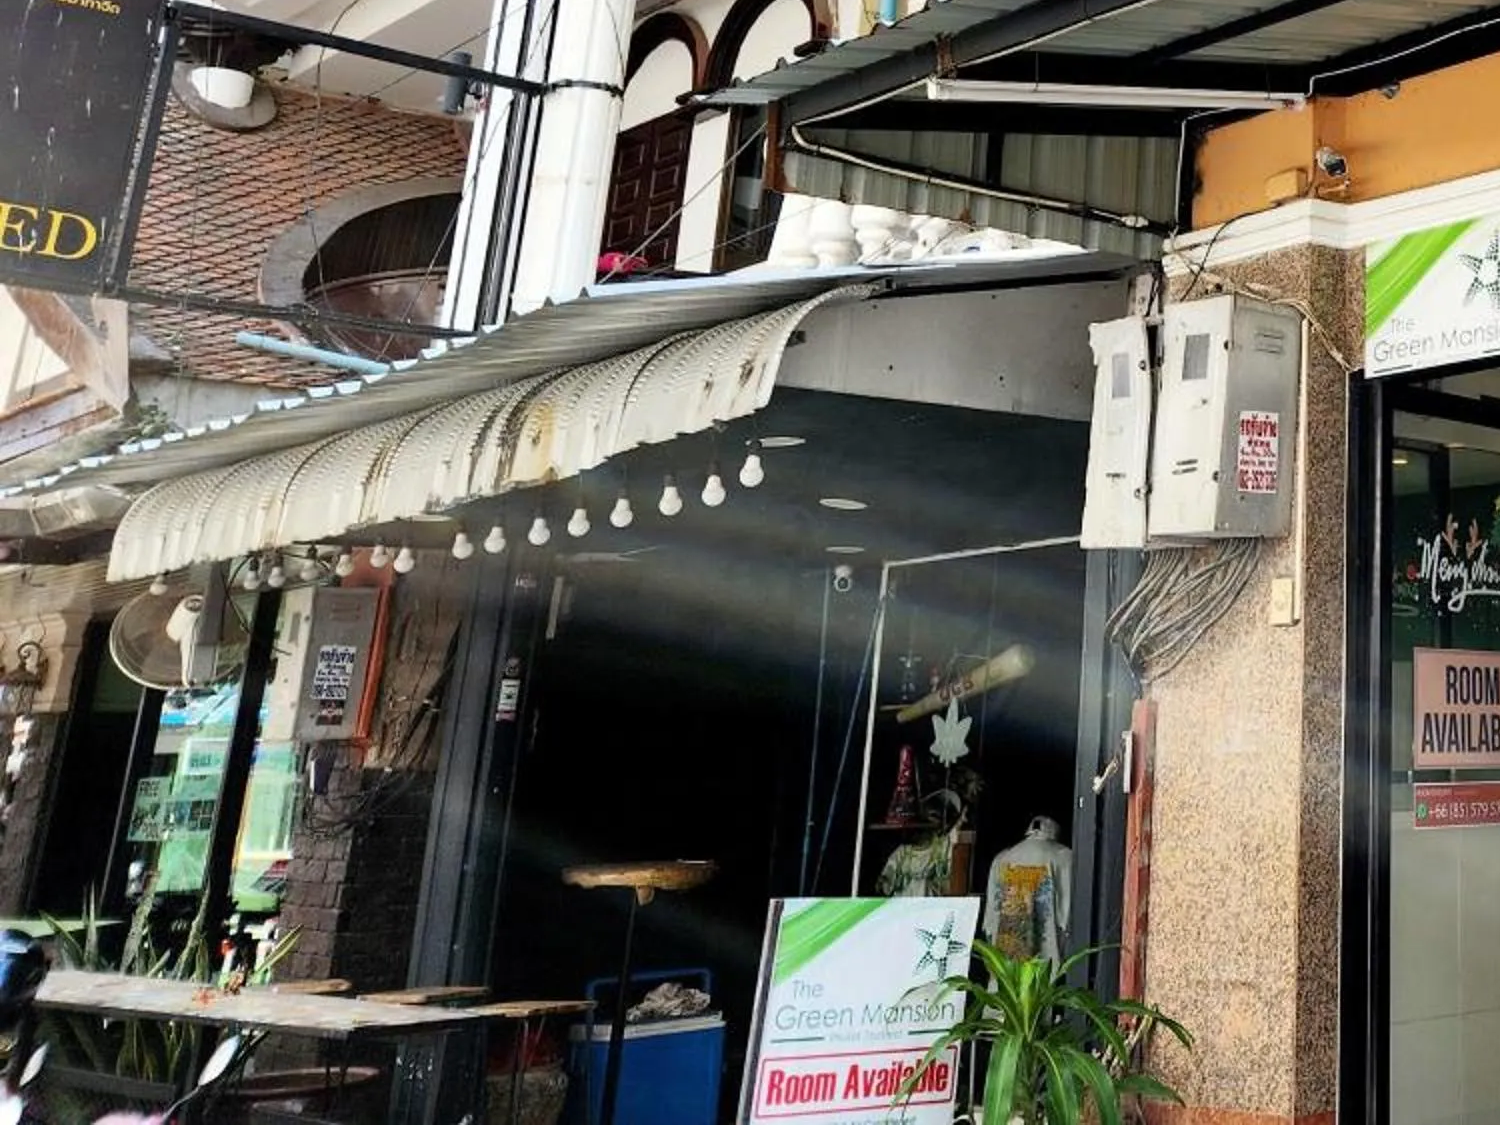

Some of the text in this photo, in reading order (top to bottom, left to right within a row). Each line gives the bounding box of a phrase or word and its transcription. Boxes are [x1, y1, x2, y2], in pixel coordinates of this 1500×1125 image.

[1373, 334, 1434, 363] Green
[1445, 665, 1500, 706] ROOM
[792, 980, 824, 999] The
[775, 999, 956, 1031] Green Mansion
[765, 1068, 838, 1107] Room
